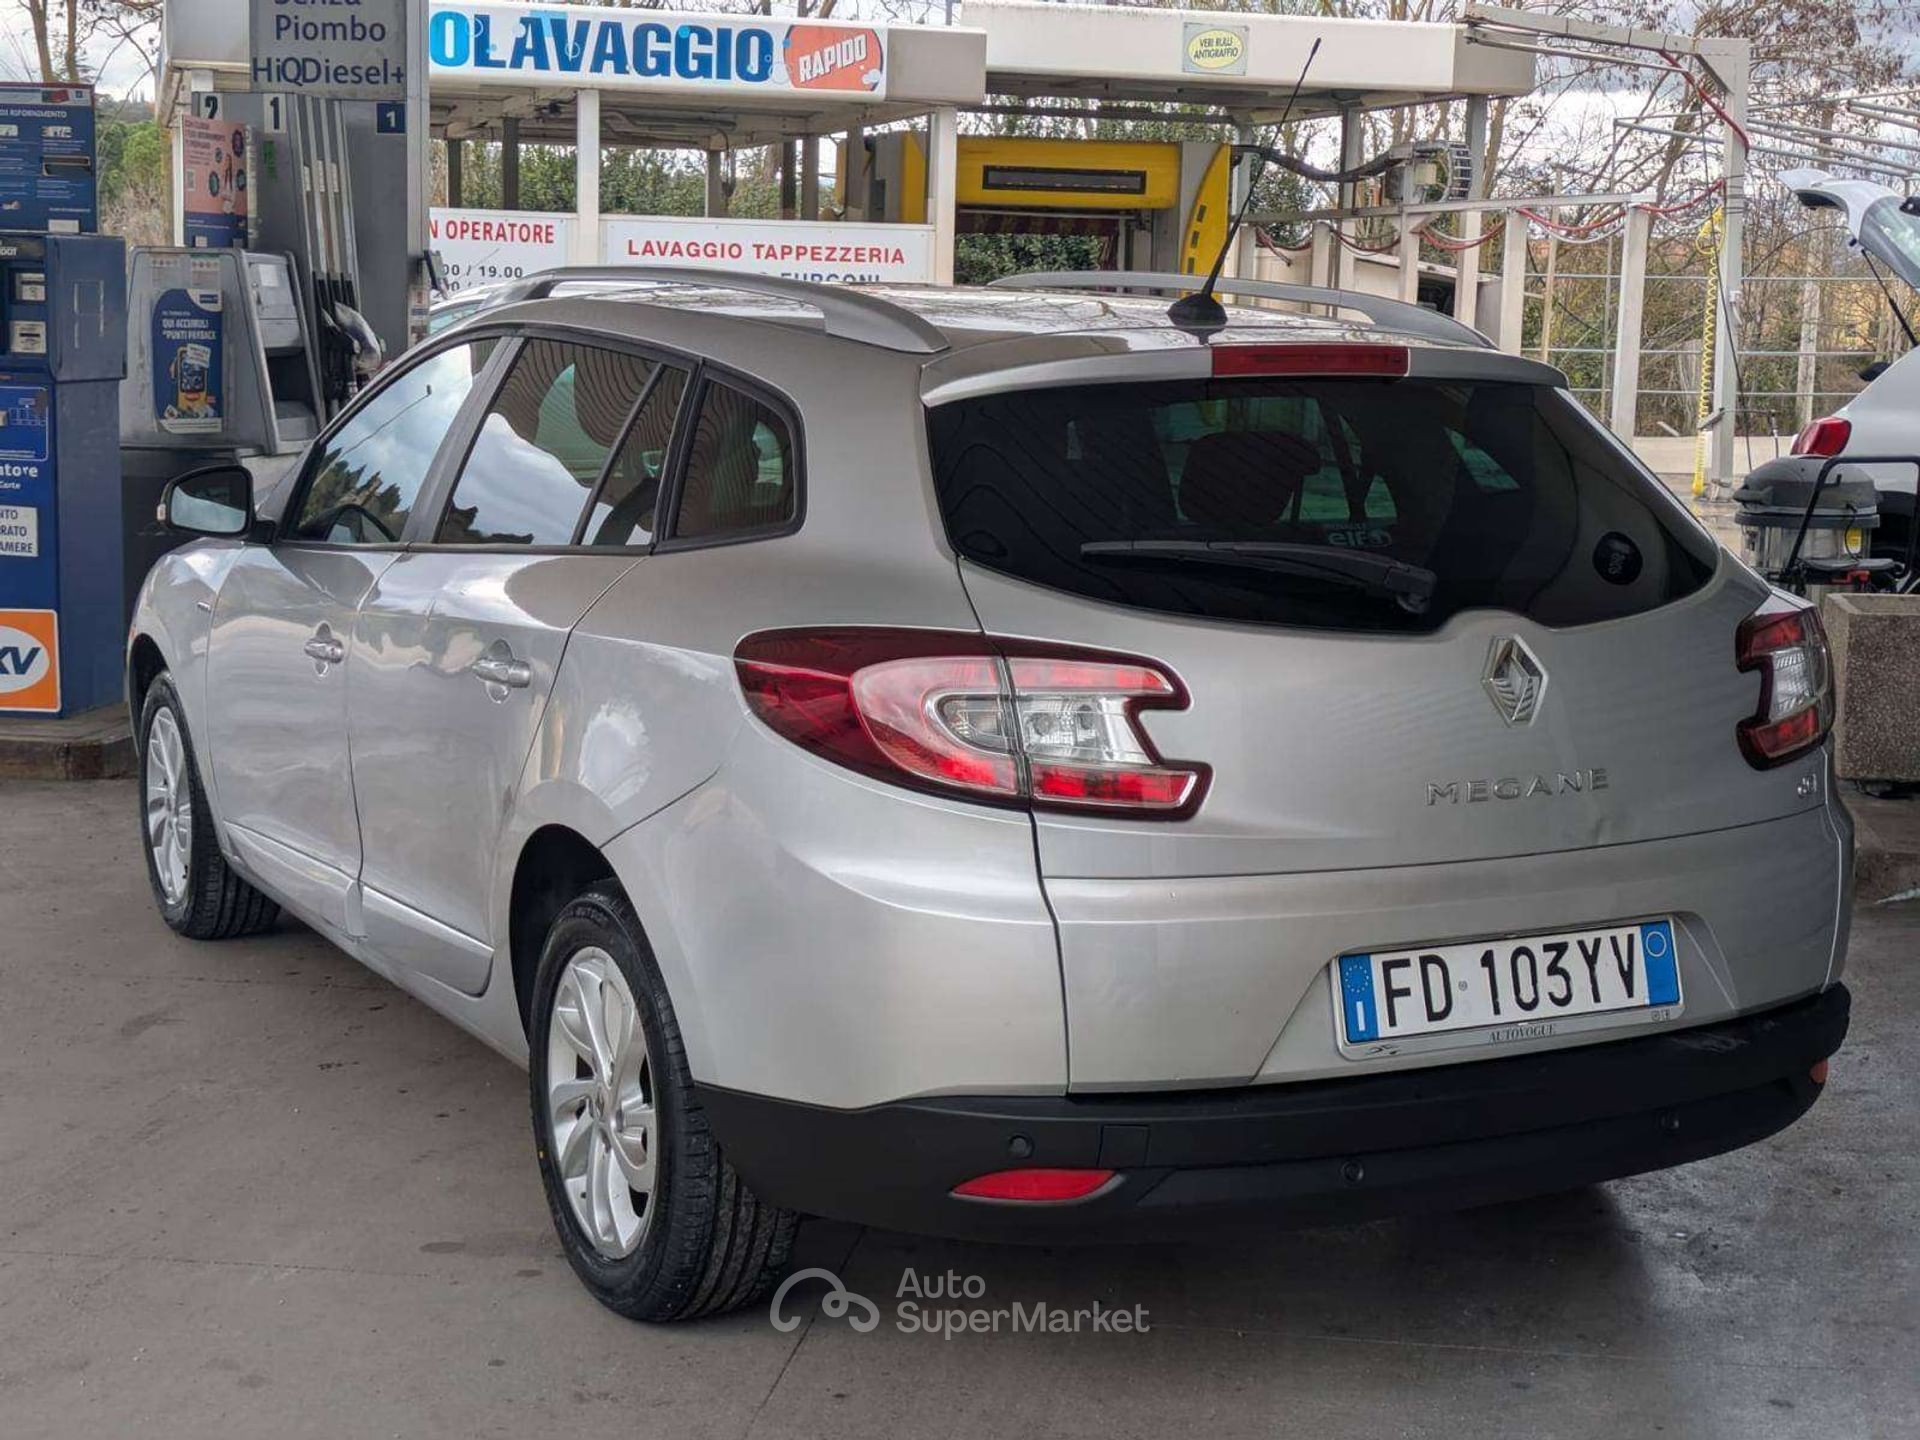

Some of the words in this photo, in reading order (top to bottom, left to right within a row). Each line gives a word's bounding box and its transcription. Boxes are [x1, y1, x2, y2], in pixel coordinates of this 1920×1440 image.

[276, 14, 386, 42] Piombo
[799, 33, 868, 83] RAPIDO
[270, 96, 280, 130] 1
[386, 111, 396, 129] 1
[446, 220, 554, 244] OPERATORE
[628, 240, 742, 260] LAVAGGIO
[752, 244, 905, 264] TAPPEZZERIA
[479, 265, 523, 278] 19.00
[1426, 768, 1609, 806] MEGANE
[1381, 953, 1452, 1027] FD
[1488, 1023, 1555, 1045] AUTOVOGUE
